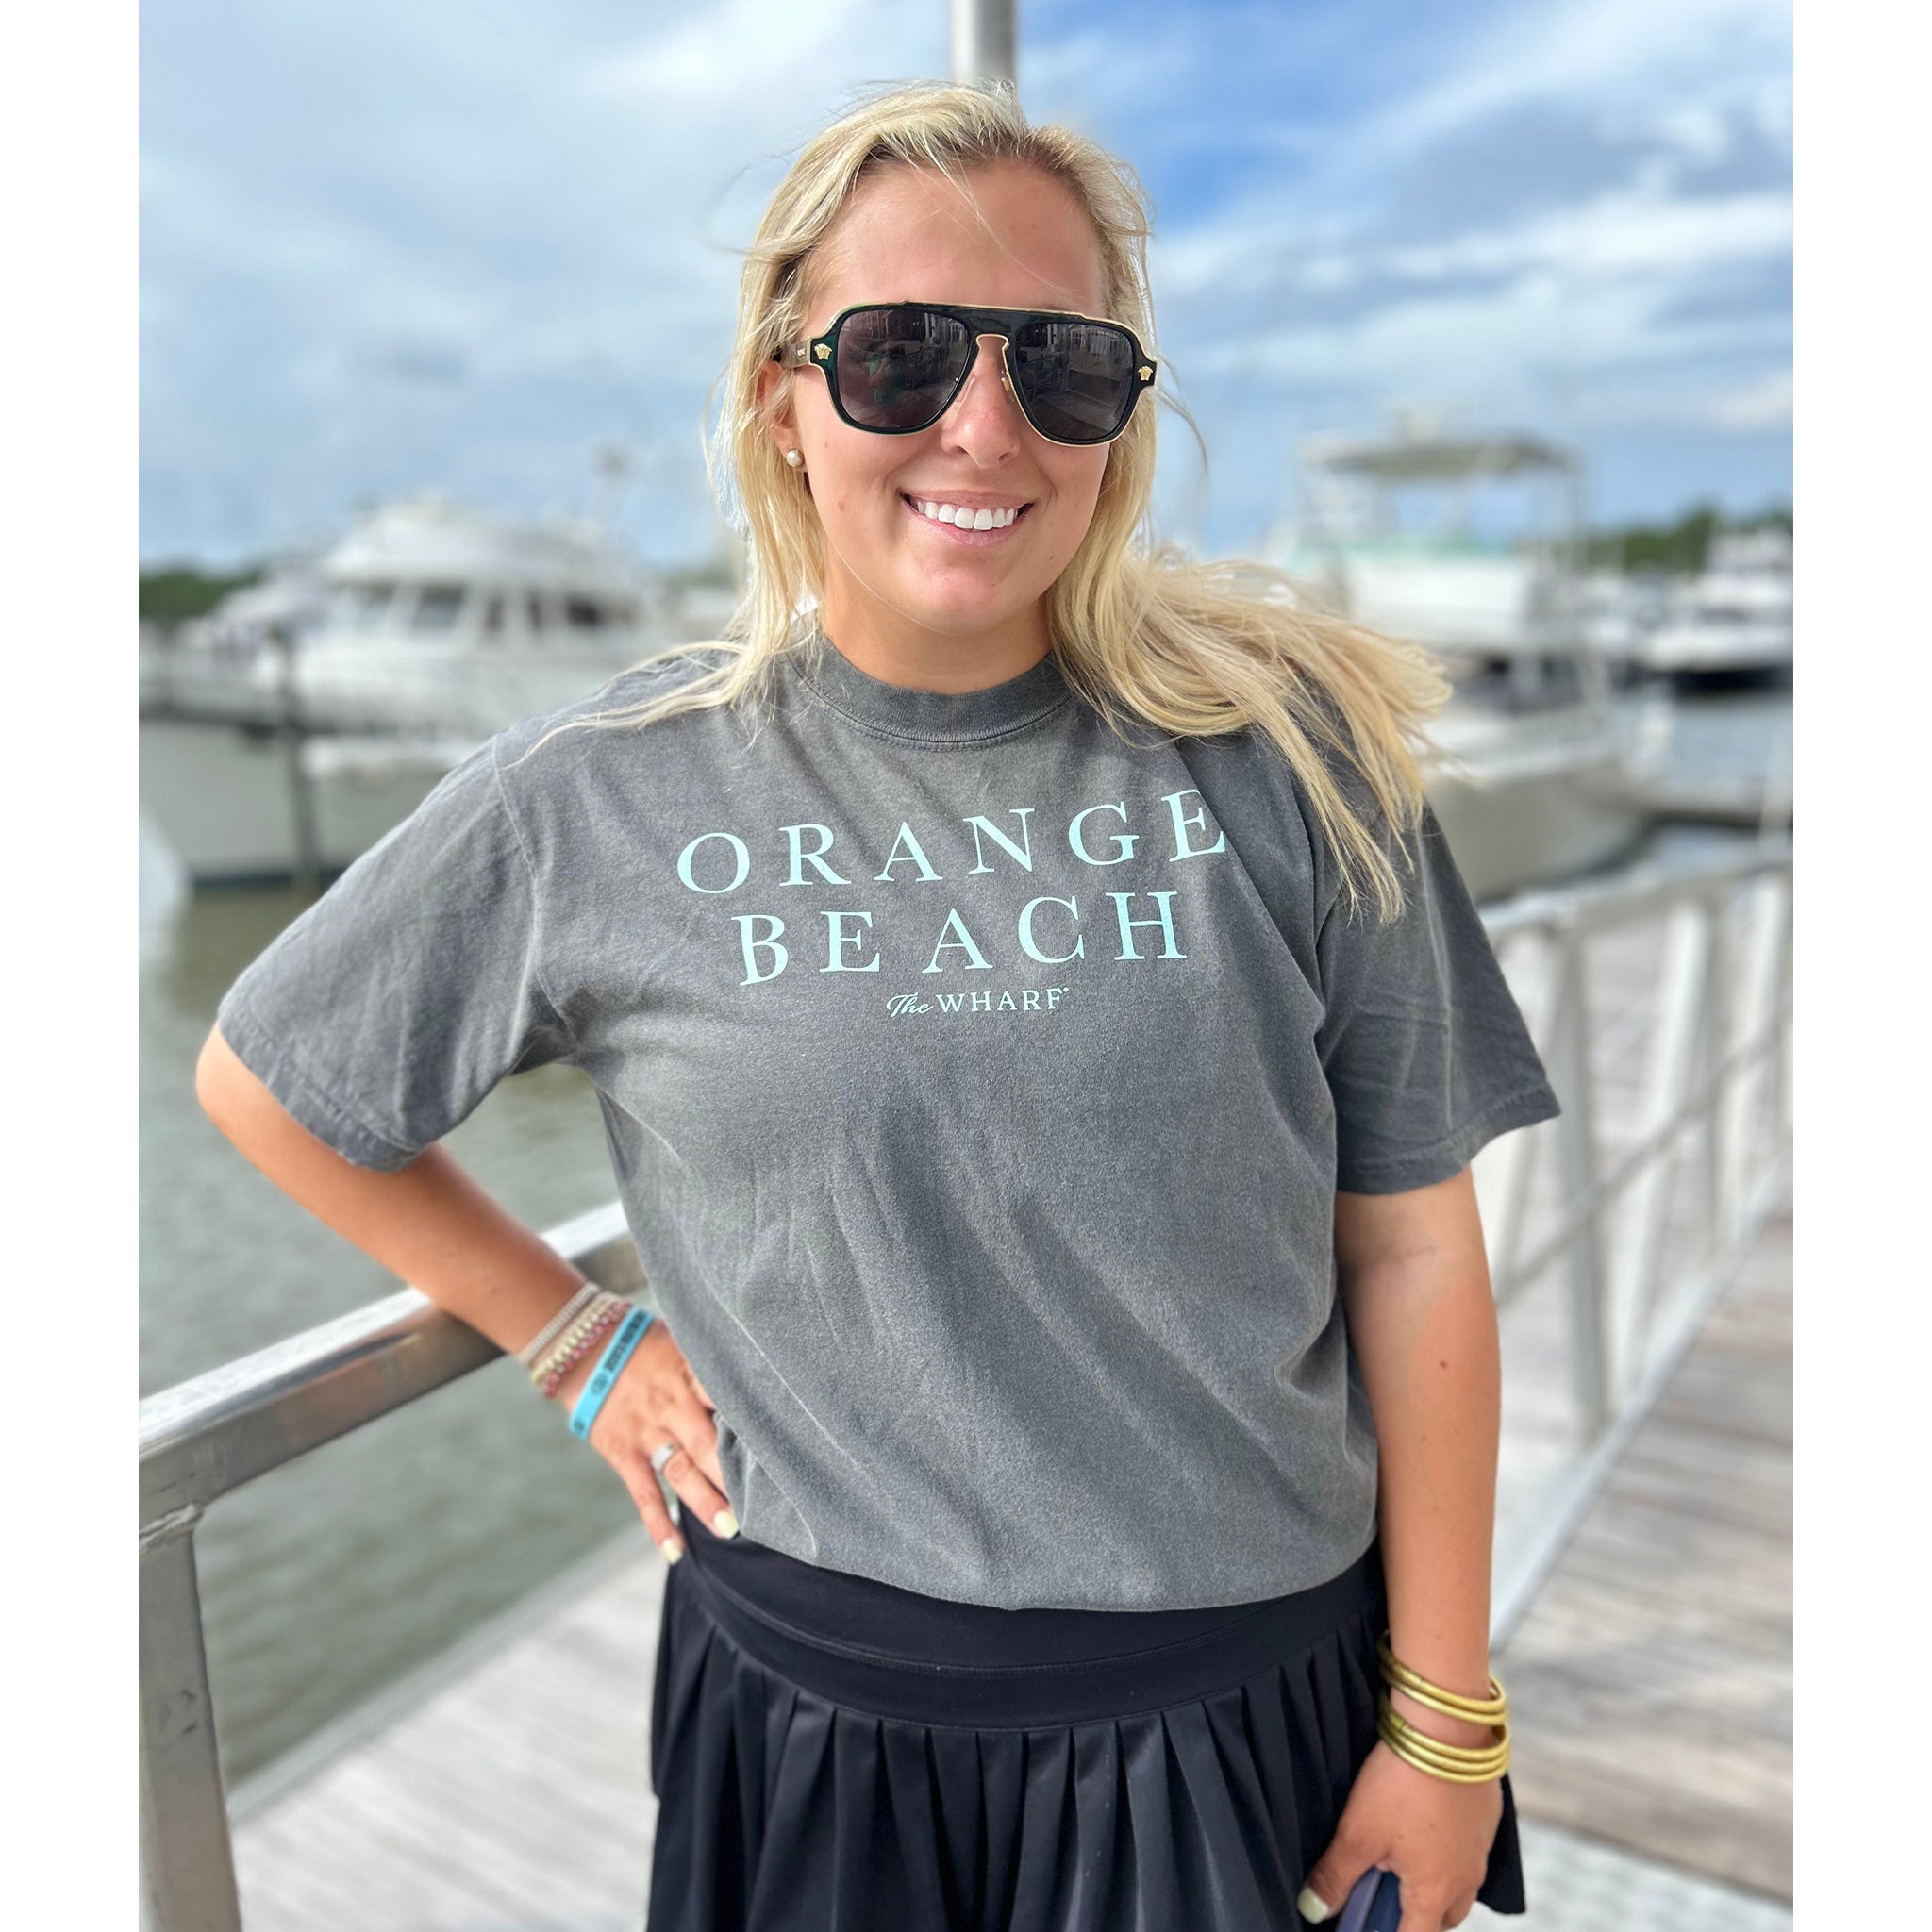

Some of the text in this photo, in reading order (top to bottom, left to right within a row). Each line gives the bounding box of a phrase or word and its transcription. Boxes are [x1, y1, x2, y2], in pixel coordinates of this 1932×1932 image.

[676, 789, 1226, 894] ORANGE
[730, 891, 1187, 987] BEACH
[886, 987, 1065, 1018] The WHARF
